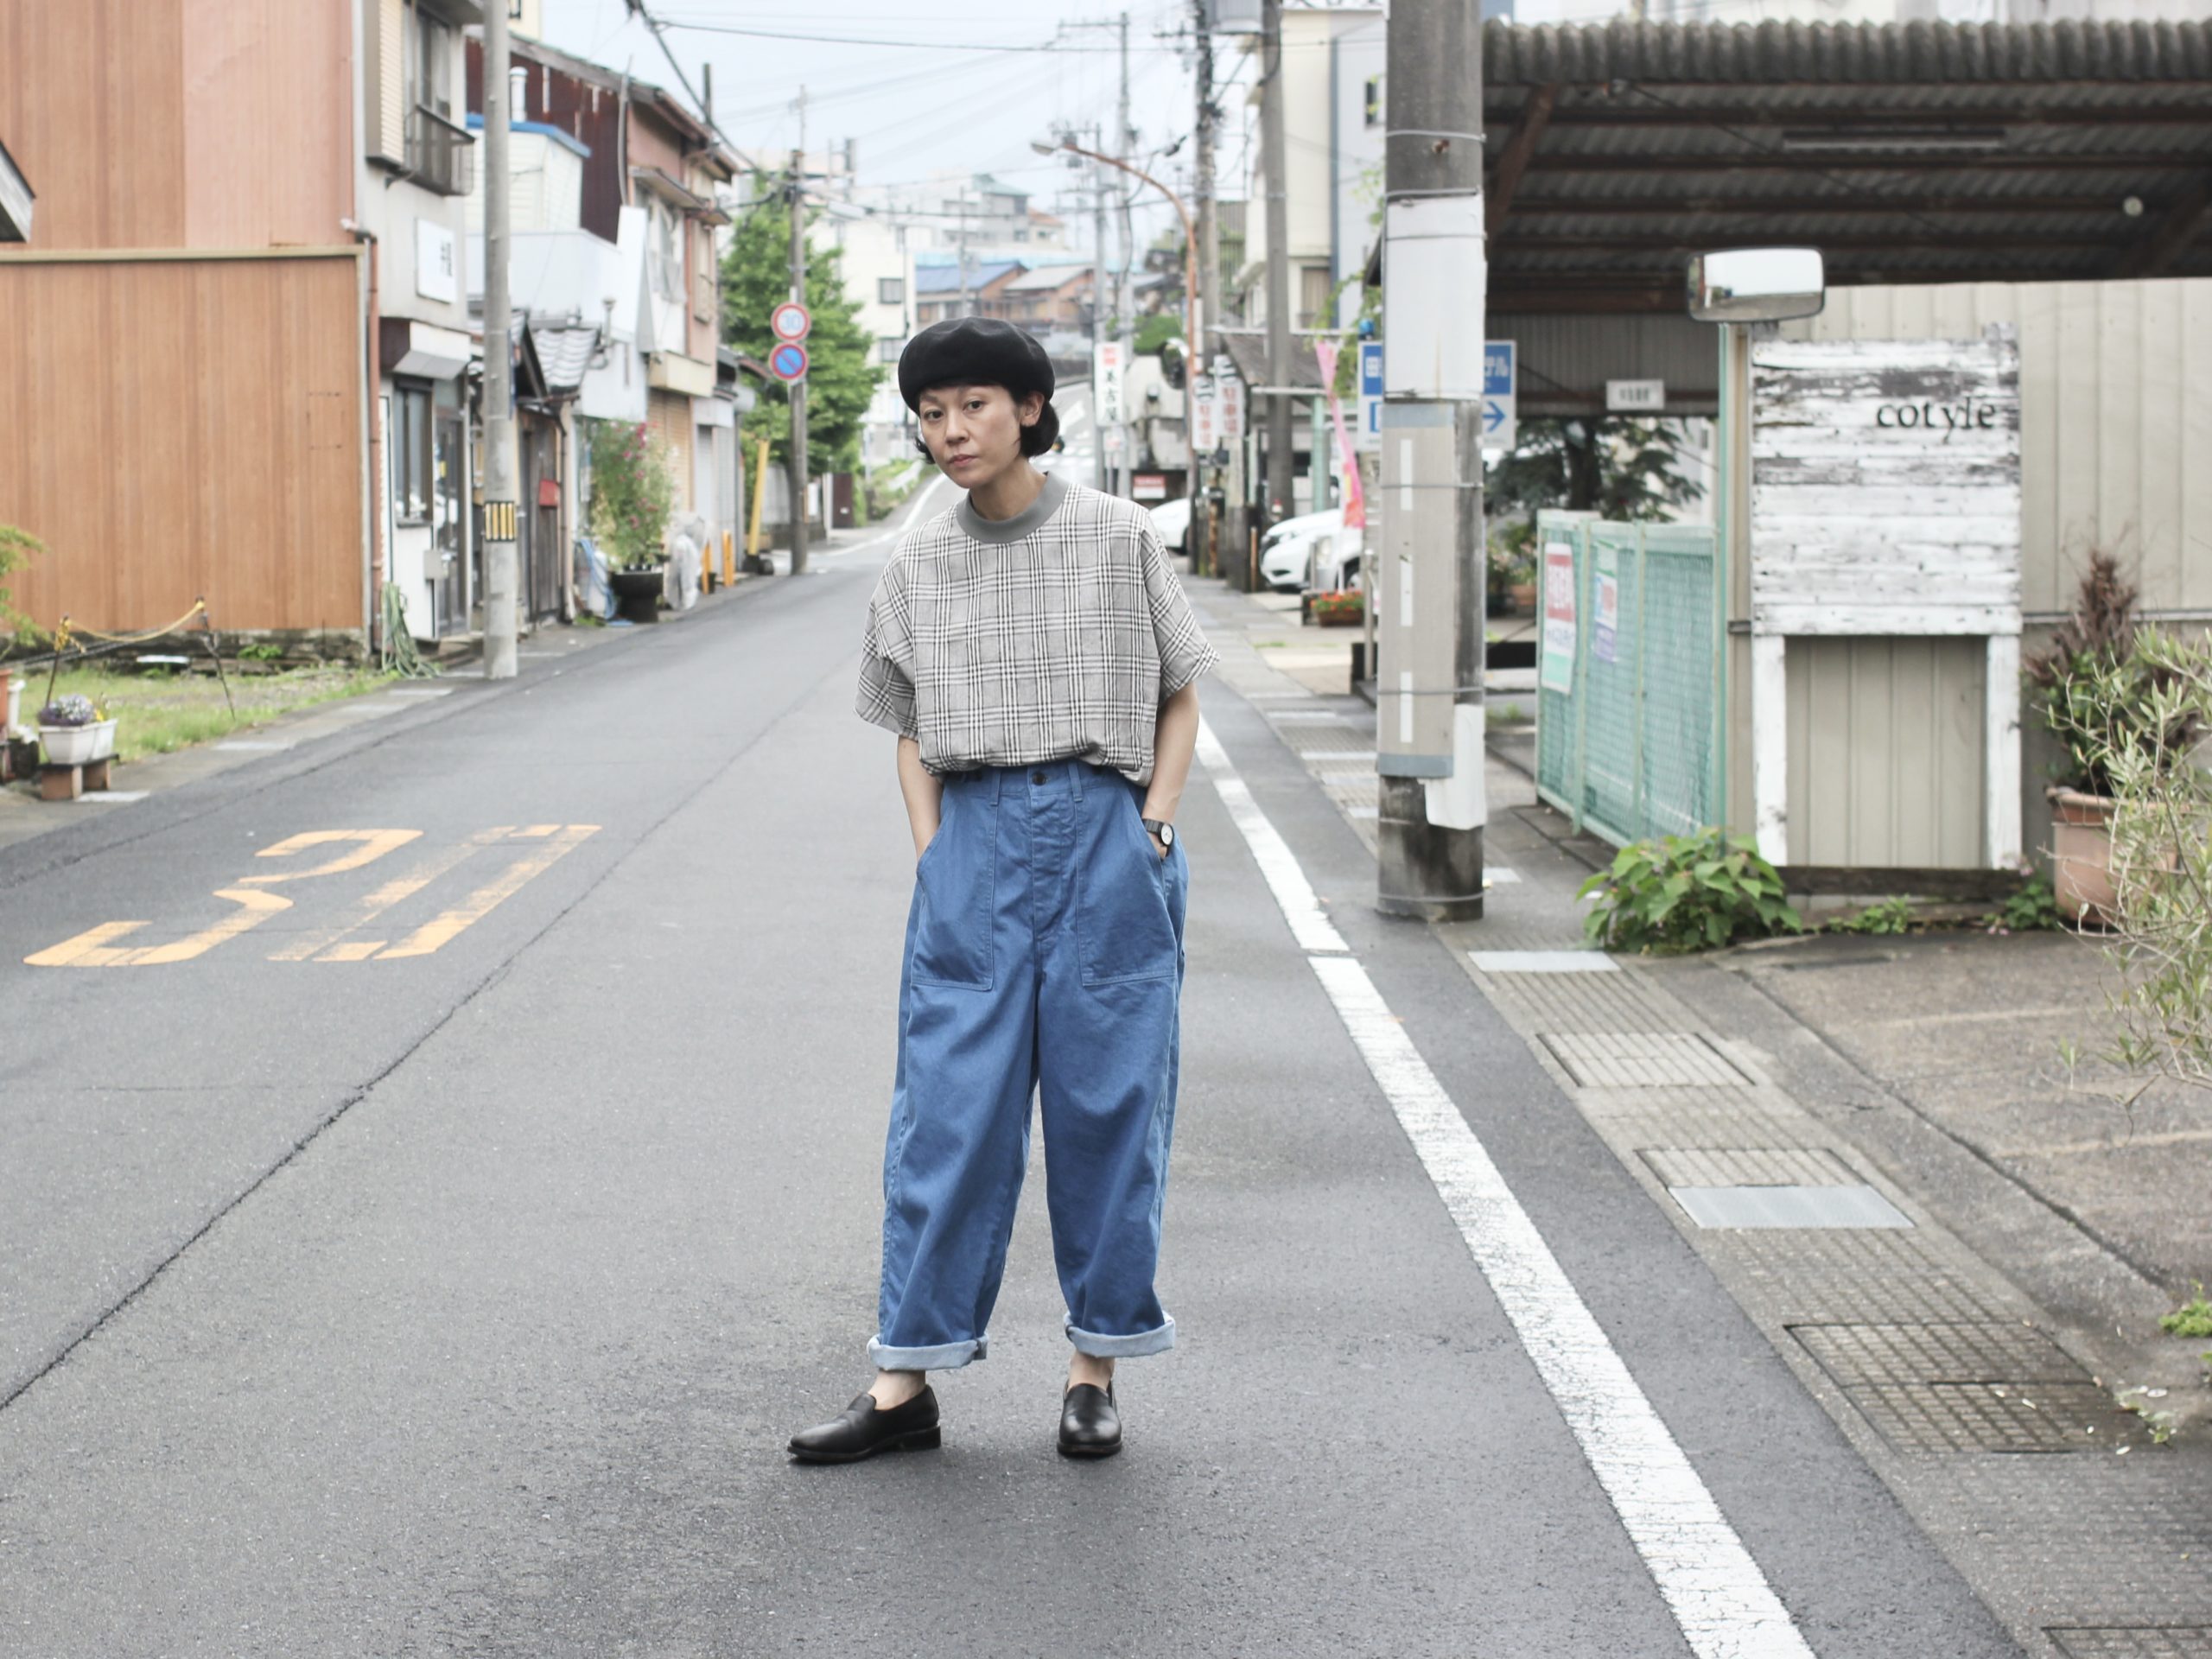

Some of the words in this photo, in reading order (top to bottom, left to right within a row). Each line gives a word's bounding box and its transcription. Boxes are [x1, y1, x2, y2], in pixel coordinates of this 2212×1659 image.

[781, 312, 801, 331] 30
[1877, 396, 1997, 444] cotyle
[23, 824, 602, 966] 30
